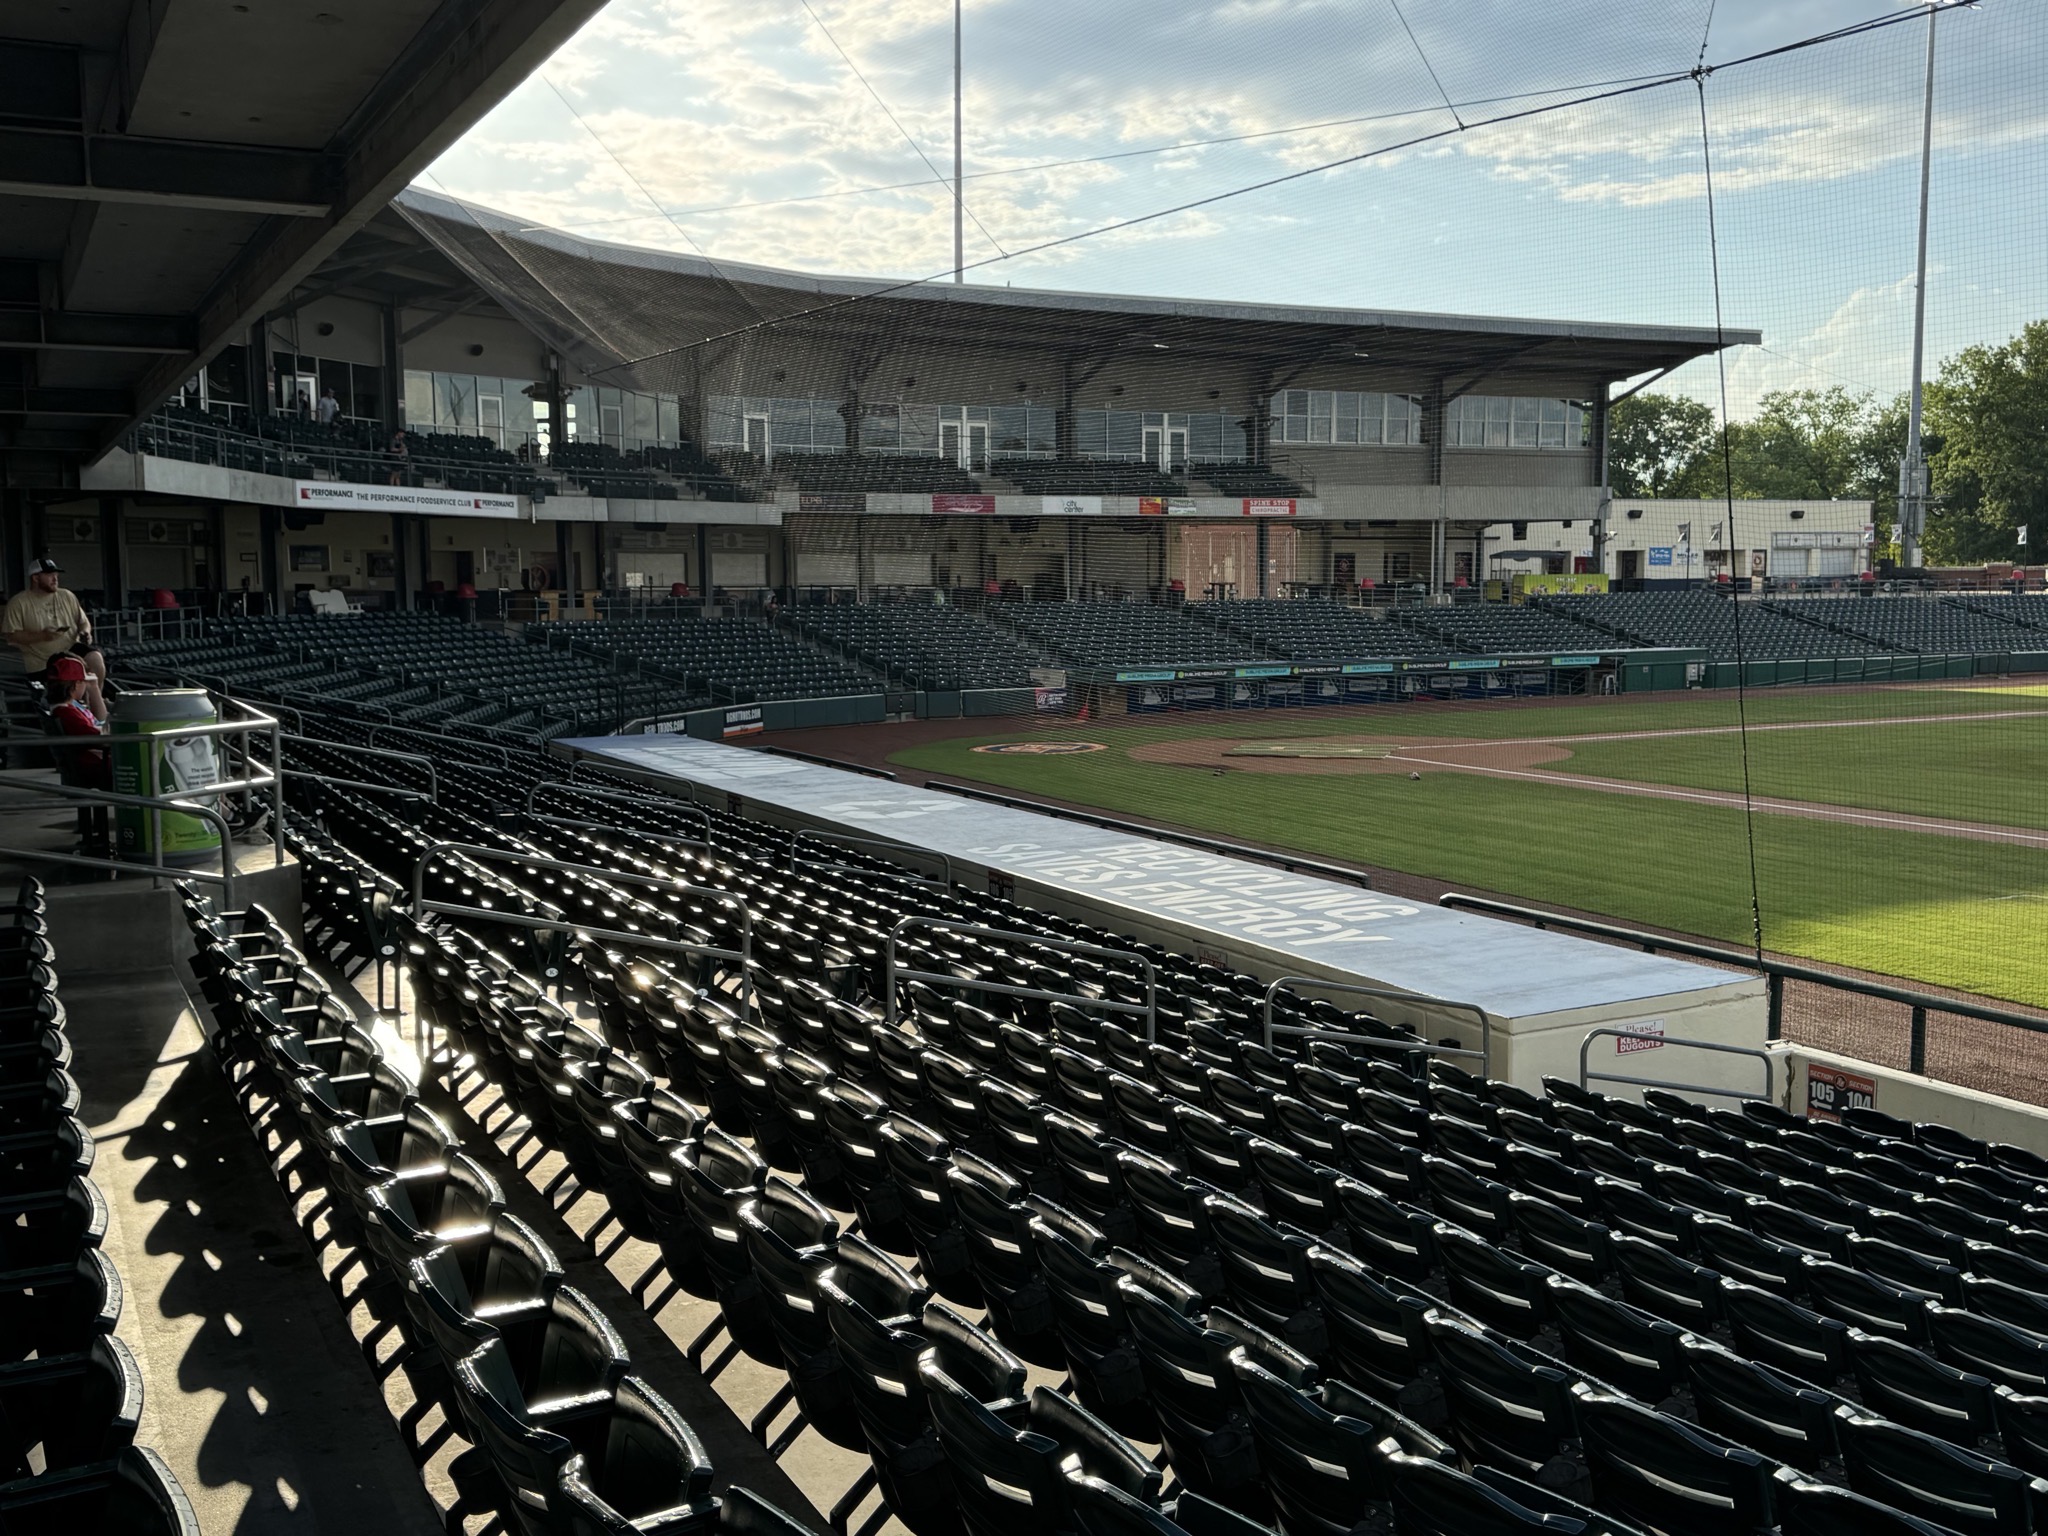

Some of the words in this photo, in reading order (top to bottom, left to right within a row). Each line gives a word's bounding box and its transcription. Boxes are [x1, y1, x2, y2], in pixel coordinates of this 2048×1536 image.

[311, 488, 353, 498] PERFORMANCE
[356, 493, 369, 501] THE
[370, 493, 415, 503] PERFORMANCE
[416, 496, 456, 506] FOODSERVICE
[482, 499, 515, 508] PERFORMANCE
[1080, 842, 1421, 922] RECYCLING
[966, 843, 1148, 884] SAVES
[1100, 881, 1394, 946] ENERGY
[1626, 1021, 1657, 1033] Please!
[1620, 1040, 1662, 1052] DUGOUTS
[1809, 1069, 1834, 1081] SECTION
[1809, 1081, 1835, 1103] 105
[1848, 1080, 1874, 1092] SECTION
[1846, 1091, 1872, 1109] 104
